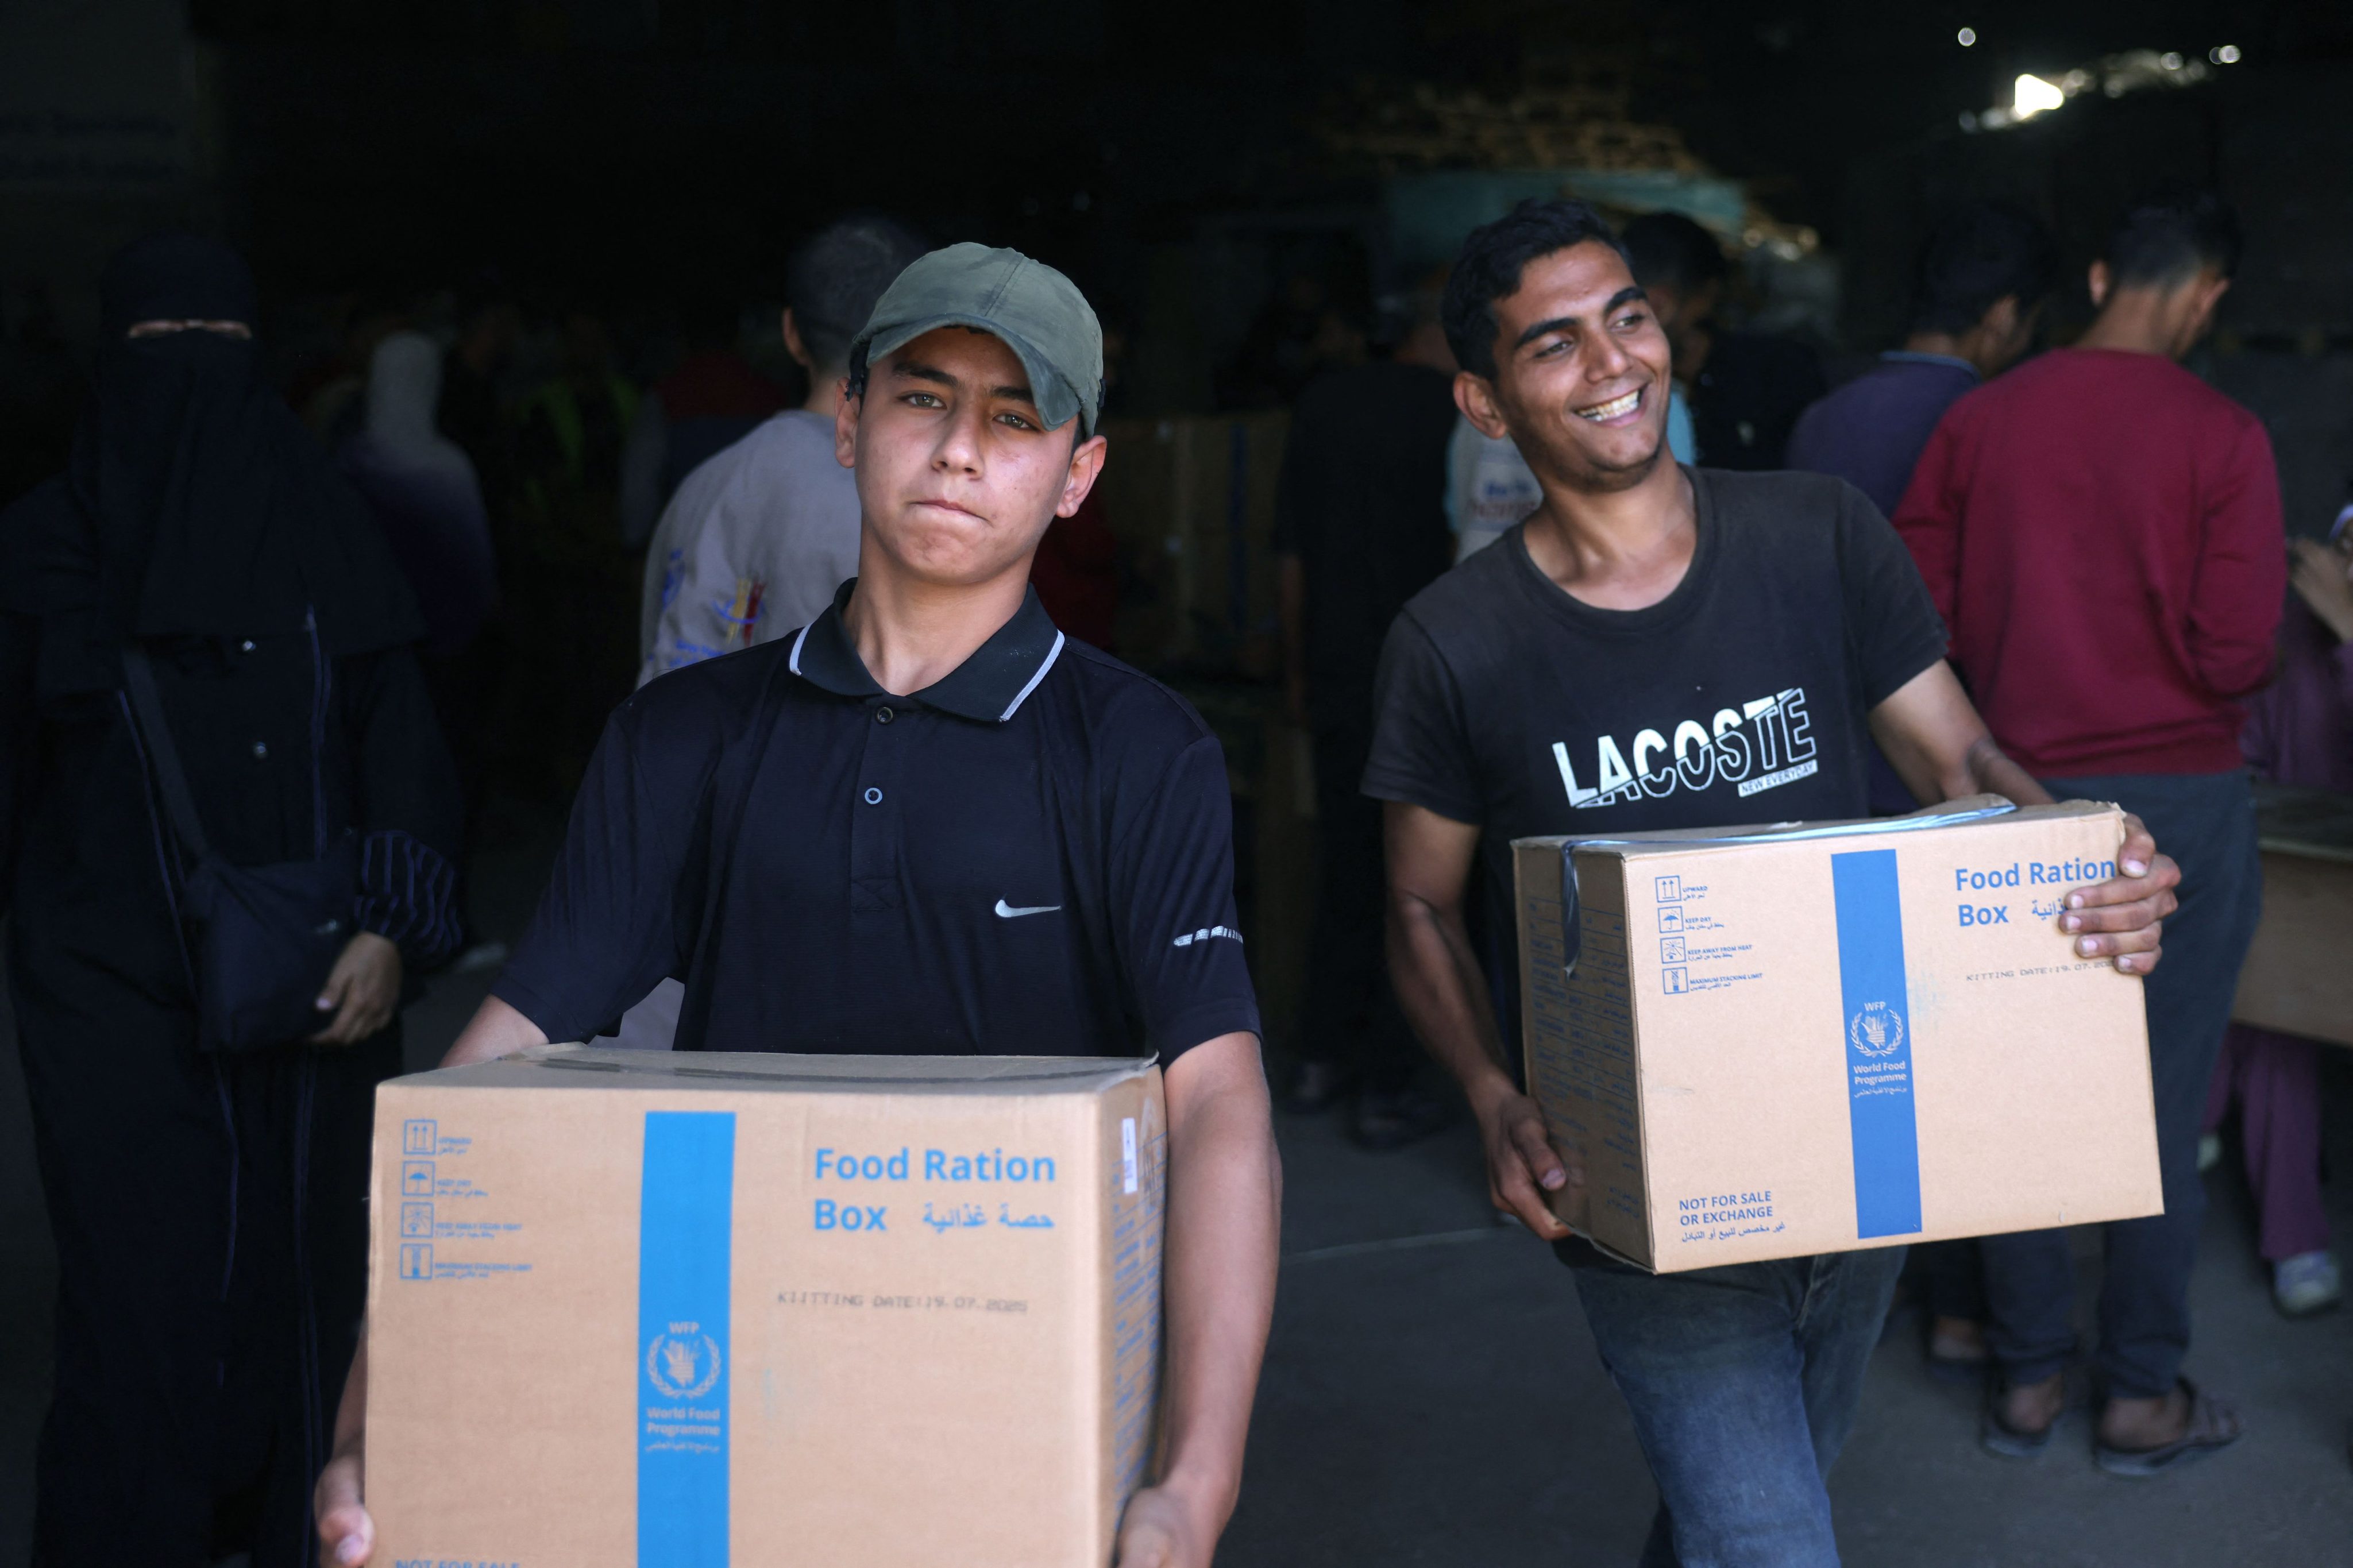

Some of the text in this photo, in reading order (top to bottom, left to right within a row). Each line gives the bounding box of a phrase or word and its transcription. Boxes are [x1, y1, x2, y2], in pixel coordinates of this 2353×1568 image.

[1552, 688, 1816, 809] LACOSTE
[1741, 764, 1813, 793] NEW EVERYDAY
[1955, 858, 2116, 891] Food Ration
[1958, 904, 2009, 927] Box
[1966, 971, 2015, 981] KITTING
[1864, 1001, 1886, 1011] WFP
[1853, 1061, 1906, 1074] World Food
[1854, 1073, 1907, 1086] Programme
[815, 1146, 1056, 1182] Food Ration
[1679, 1191, 1772, 1211] NOT FOR SALE
[813, 1198, 888, 1231] Box
[998, 1202, 1055, 1229] حصة
[1680, 1206, 1773, 1226] OR EXCHANGE
[669, 1320, 700, 1334] WFP
[647, 1407, 720, 1420] World Food
[647, 1422, 721, 1437] Programme
